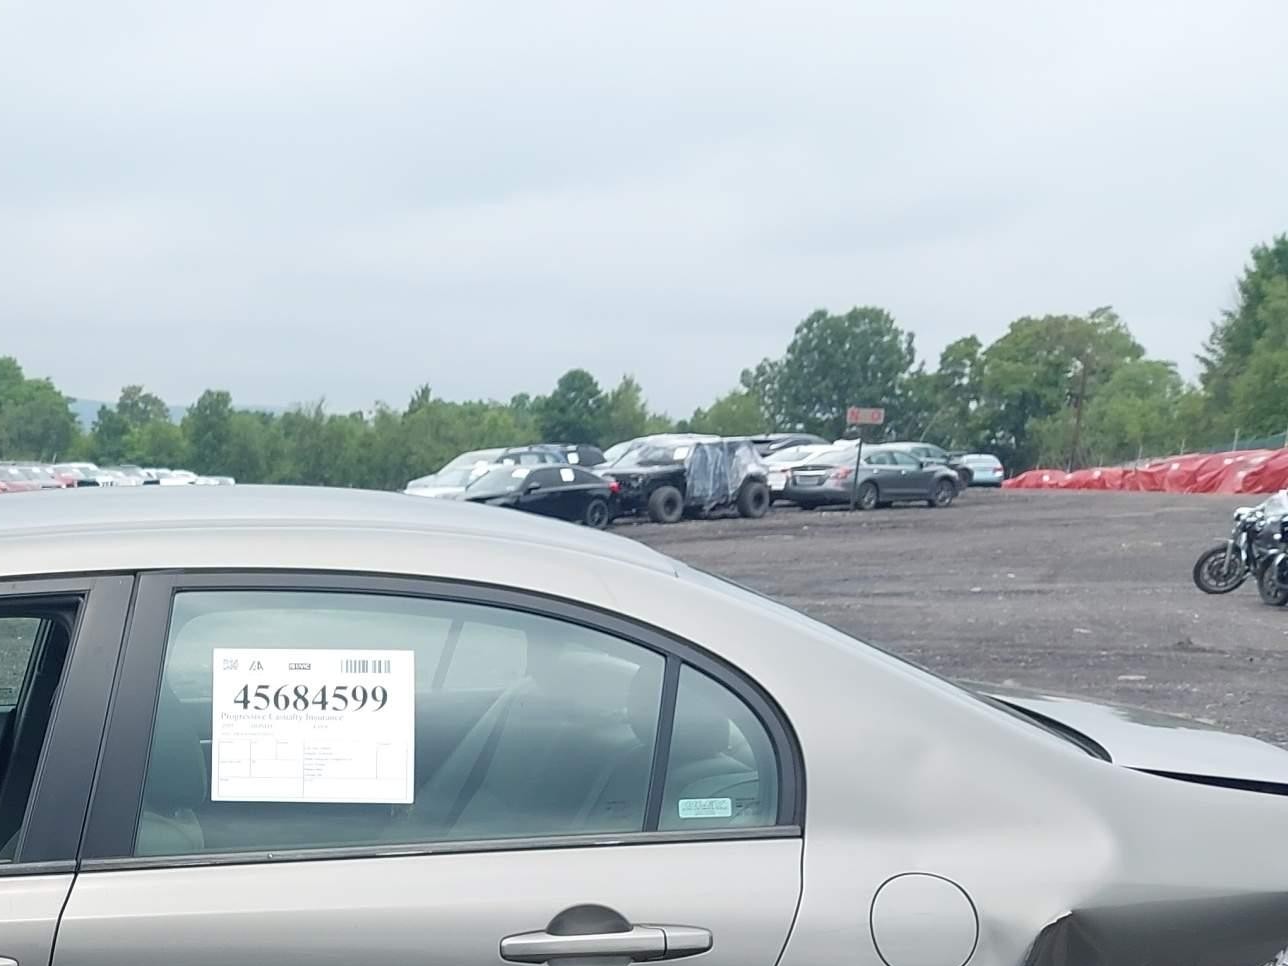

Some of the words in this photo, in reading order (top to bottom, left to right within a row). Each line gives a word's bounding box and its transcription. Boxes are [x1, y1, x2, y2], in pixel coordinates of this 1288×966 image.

[233, 683, 388, 712] 45684599
[220, 711, 266, 721] Progressive
[268, 711, 303, 721] Casualty
[305, 712, 344, 721] Insurance
